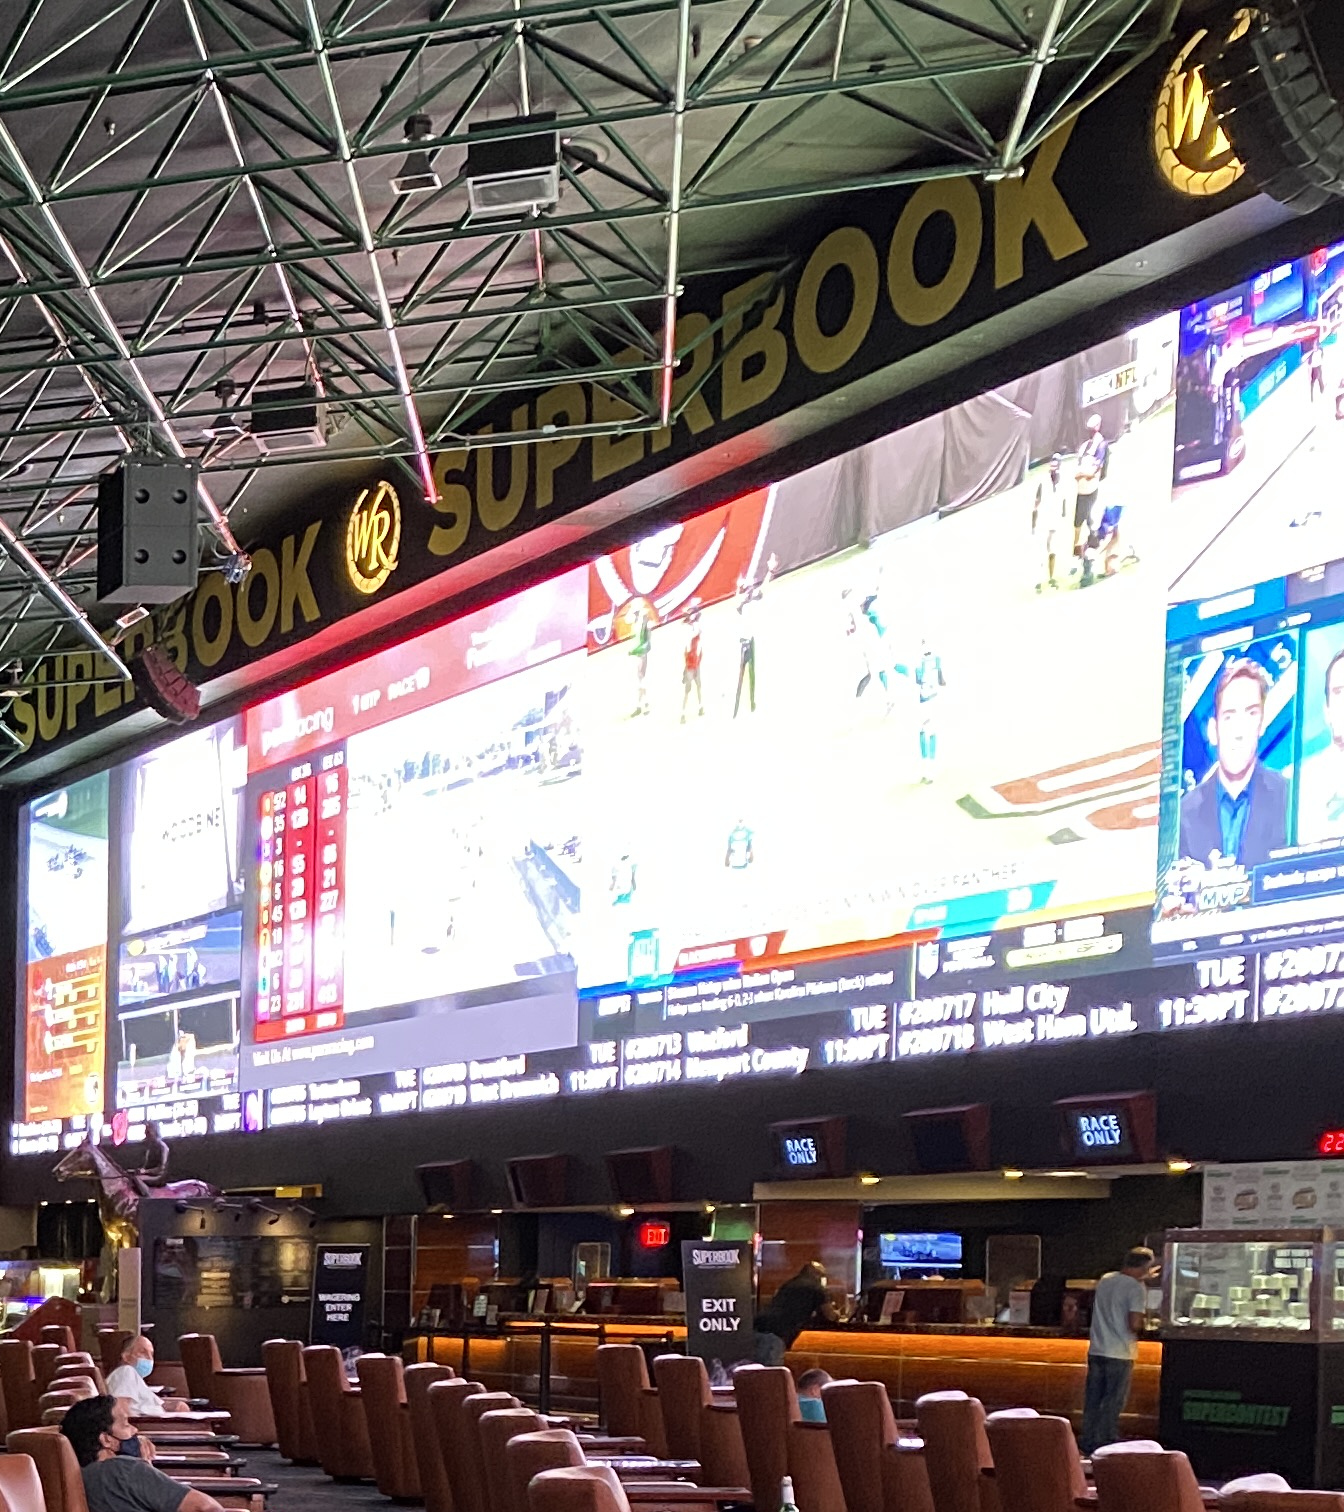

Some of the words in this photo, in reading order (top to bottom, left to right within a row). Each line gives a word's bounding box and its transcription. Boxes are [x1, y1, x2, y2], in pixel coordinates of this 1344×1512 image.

[428, 106, 1088, 556] SUPERBOOK
[1196, 955, 1246, 989] TUE
[1026, 981, 1071, 1015] City
[982, 1018, 1035, 1048] West
[1080, 1114, 1120, 1131] RACE
[786, 1137, 816, 1152] RACE
[1082, 1129, 1122, 1147] ONLY
[788, 1150, 818, 1165] ONLY
[324, 1303, 352, 1312] ENTER
[701, 1298, 737, 1312] EXIT
[699, 1317, 742, 1331] ONLY
